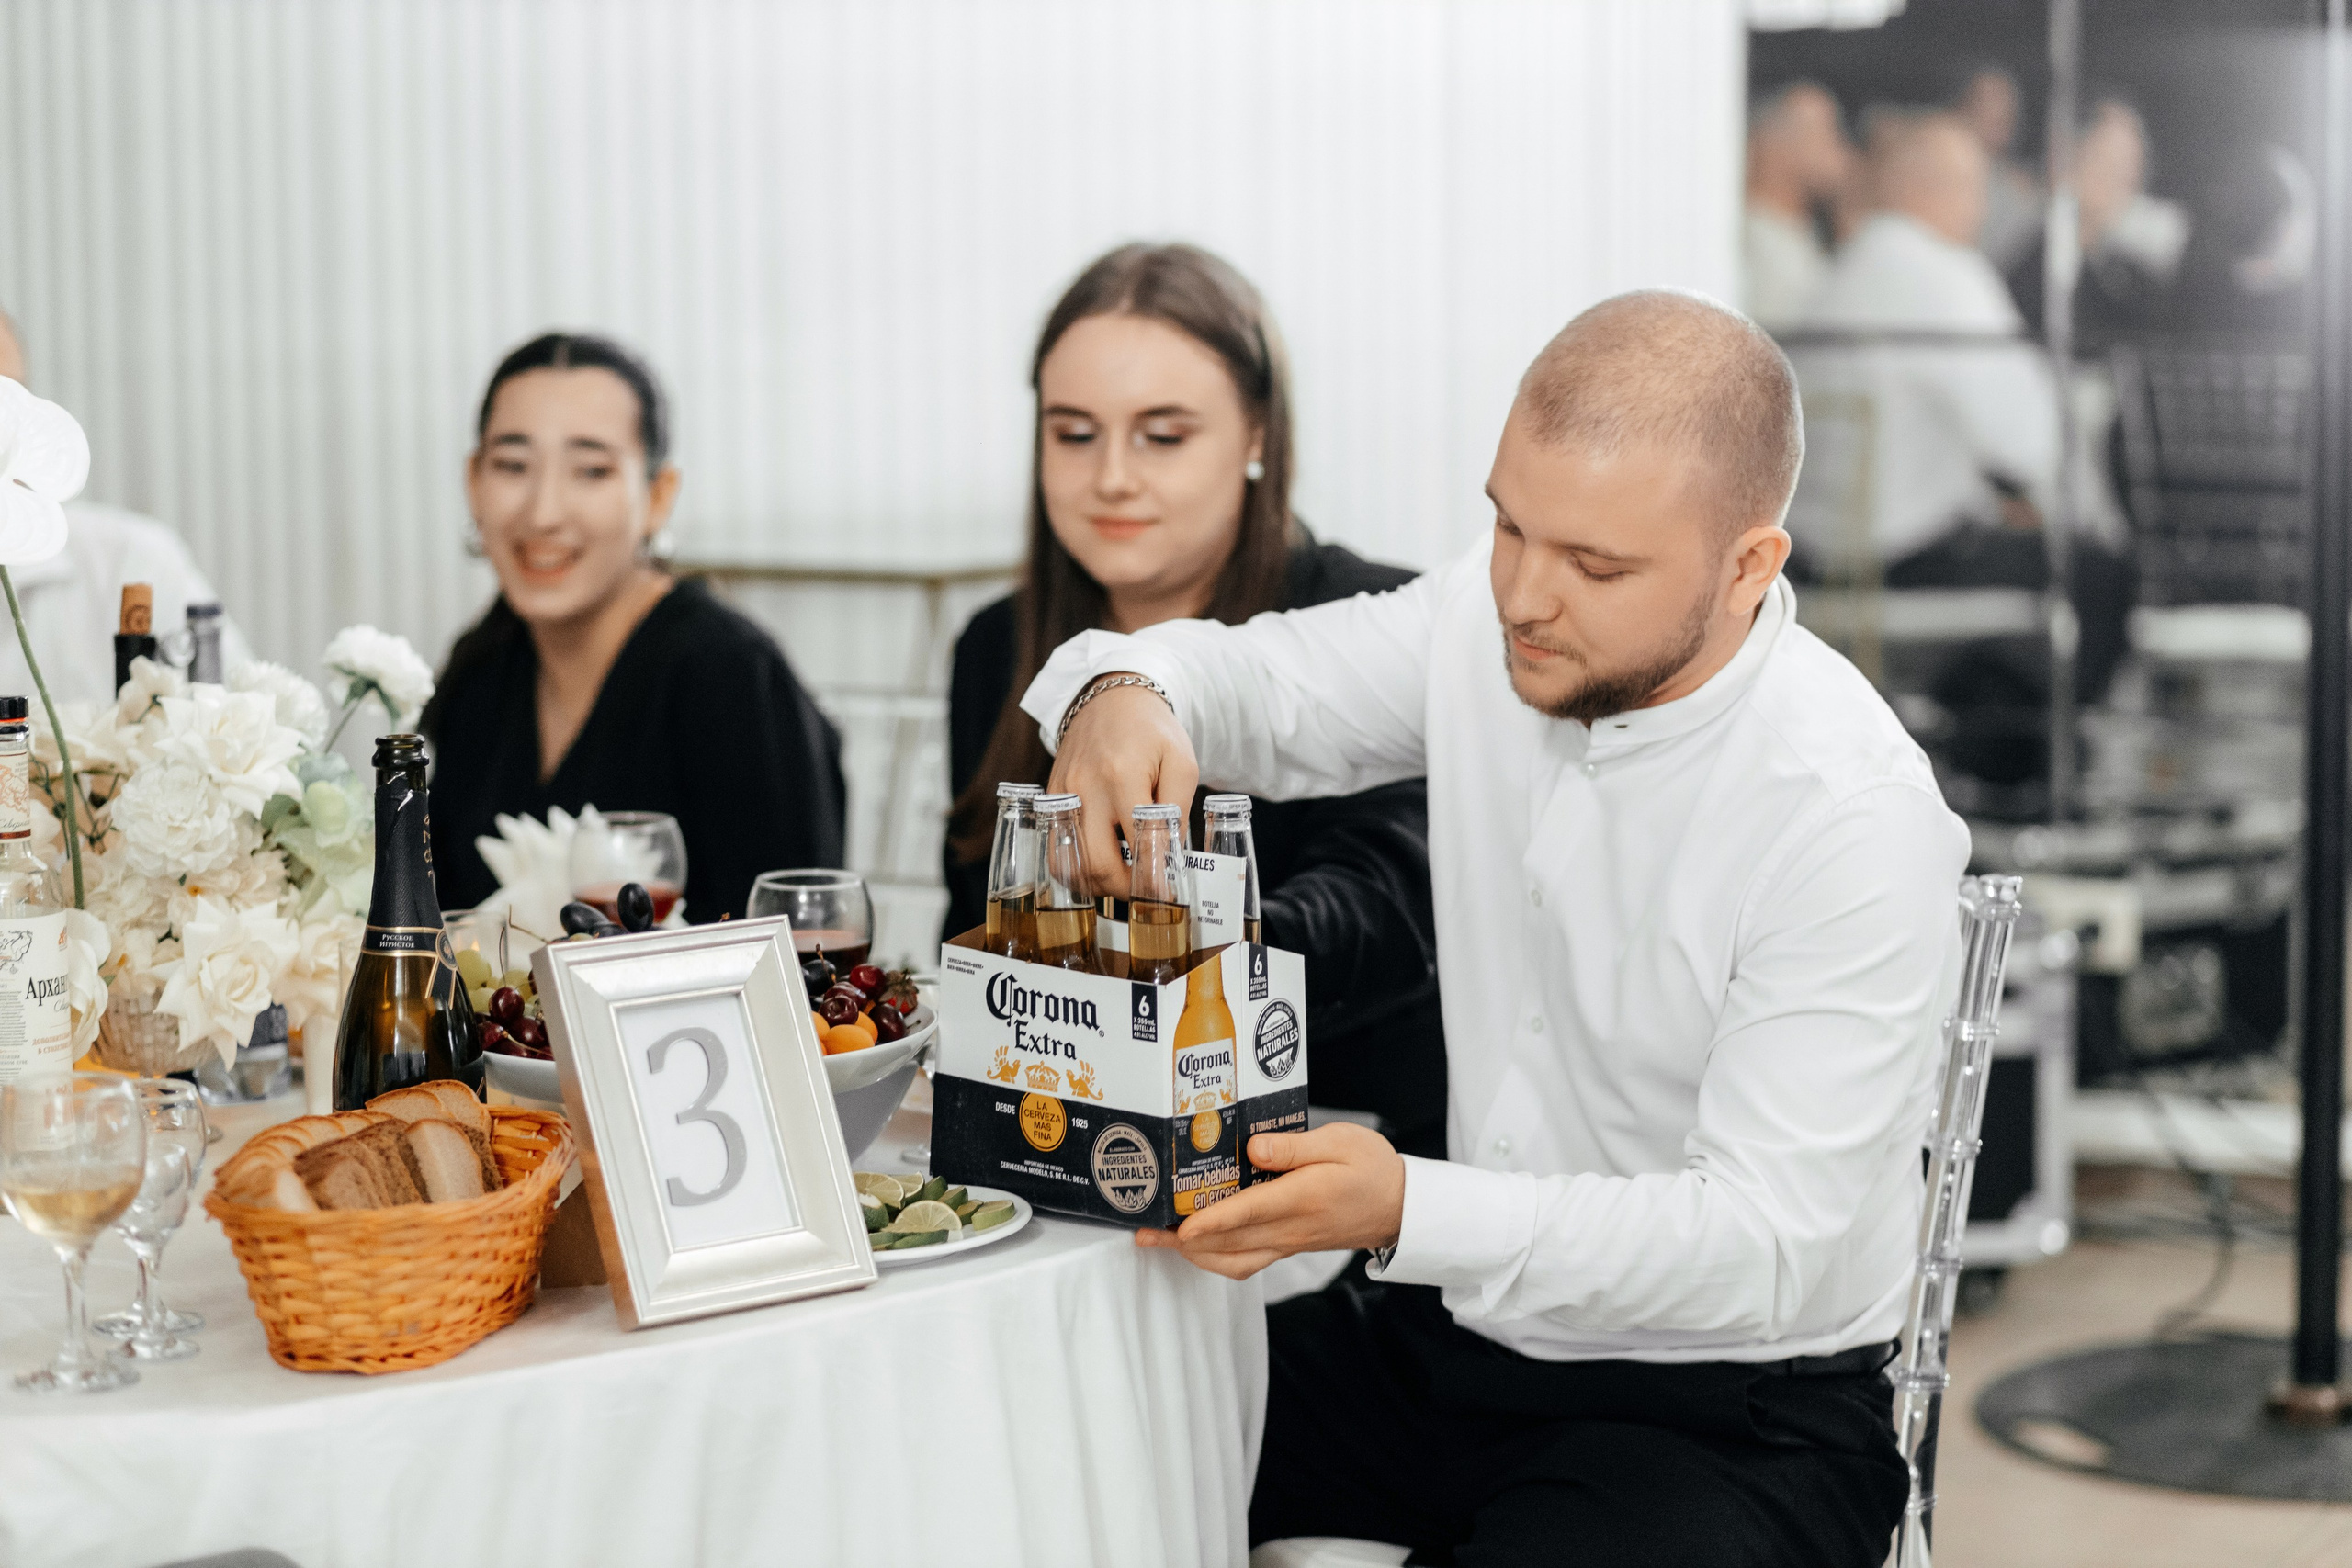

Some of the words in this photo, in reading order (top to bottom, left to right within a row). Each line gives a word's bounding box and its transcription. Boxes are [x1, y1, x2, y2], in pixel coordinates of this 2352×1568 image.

[1254, 953, 1262, 976] 6
[986, 971, 1101, 1031] Corona
[1138, 995, 1150, 1017] 6
[1133, 1023, 1156, 1034] BOTELLAS
[1261, 1020, 1293, 1045] INGREDIENTES
[1014, 1019, 1077, 1060] Extra
[1257, 1027, 1299, 1062] NATURALES
[1178, 1051, 1230, 1079] Corona
[1193, 1074, 1222, 1089] Extra
[995, 1101, 1016, 1115] DESDE
[1036, 1101, 1047, 1111] LA
[647, 1026, 748, 1208] 3
[1023, 1108, 1061, 1123] CERVEZA
[1071, 1117, 1089, 1130] 1925
[1256, 1117, 1278, 1133] TOMASTE,
[1278, 1115, 1285, 1127] NO
[1034, 1121, 1052, 1132] MAS
[1033, 1131, 1052, 1141] FINA
[1102, 1155, 1148, 1166] INGREDIENTES
[1000, 1160, 1028, 1173] CERVECERIA
[1028, 1167, 1049, 1179] MODELO,
[1055, 1172, 1062, 1180] DE
[1072, 1175, 1080, 1184] DE
[1098, 1166, 1155, 1182] NATURALES
[1171, 1173, 1203, 1193] Tomar
[1204, 1162, 1241, 1188] bebidas
[1194, 1192, 1206, 1210] en
